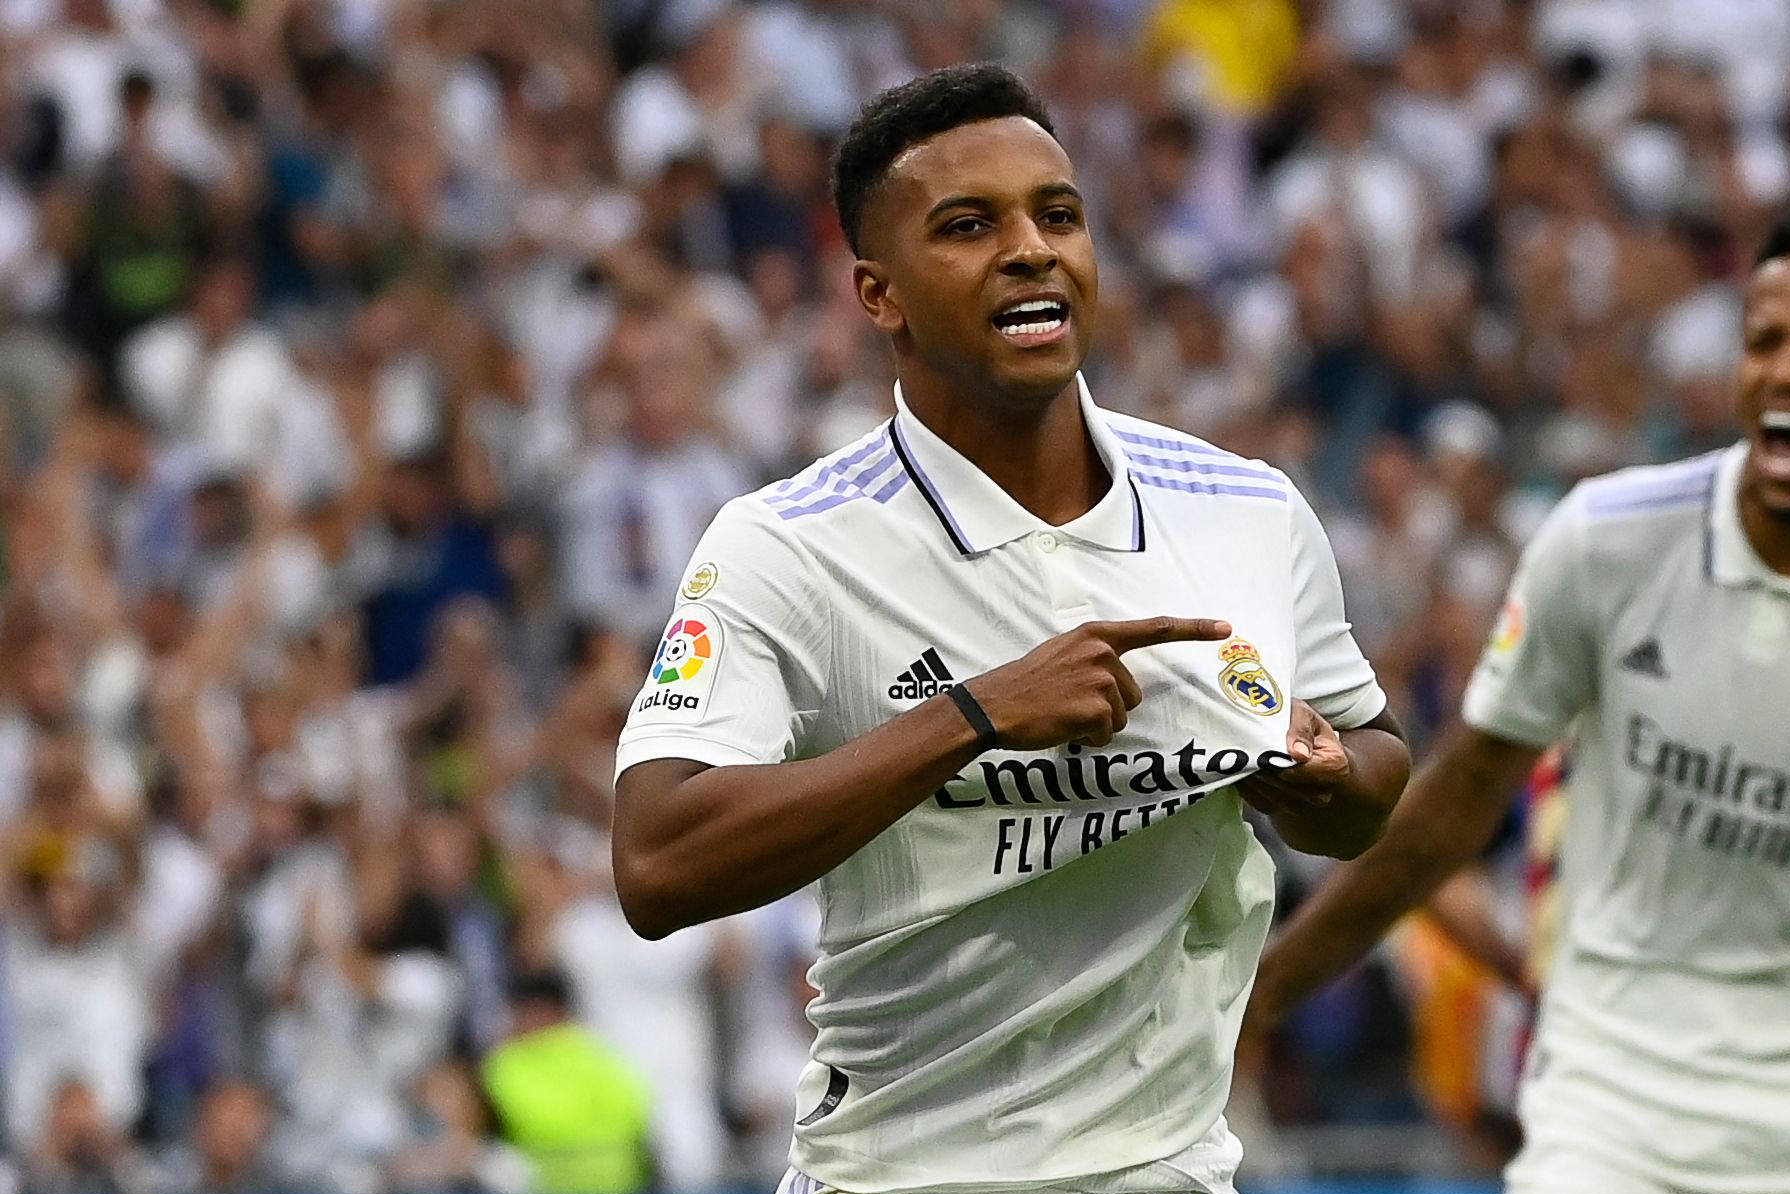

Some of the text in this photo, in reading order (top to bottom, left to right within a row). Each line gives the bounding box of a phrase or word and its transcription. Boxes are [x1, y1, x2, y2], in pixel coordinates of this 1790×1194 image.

[638, 688, 699, 711] LaLiga
[888, 680, 953, 699] adid
[994, 815, 1064, 874] FLY
